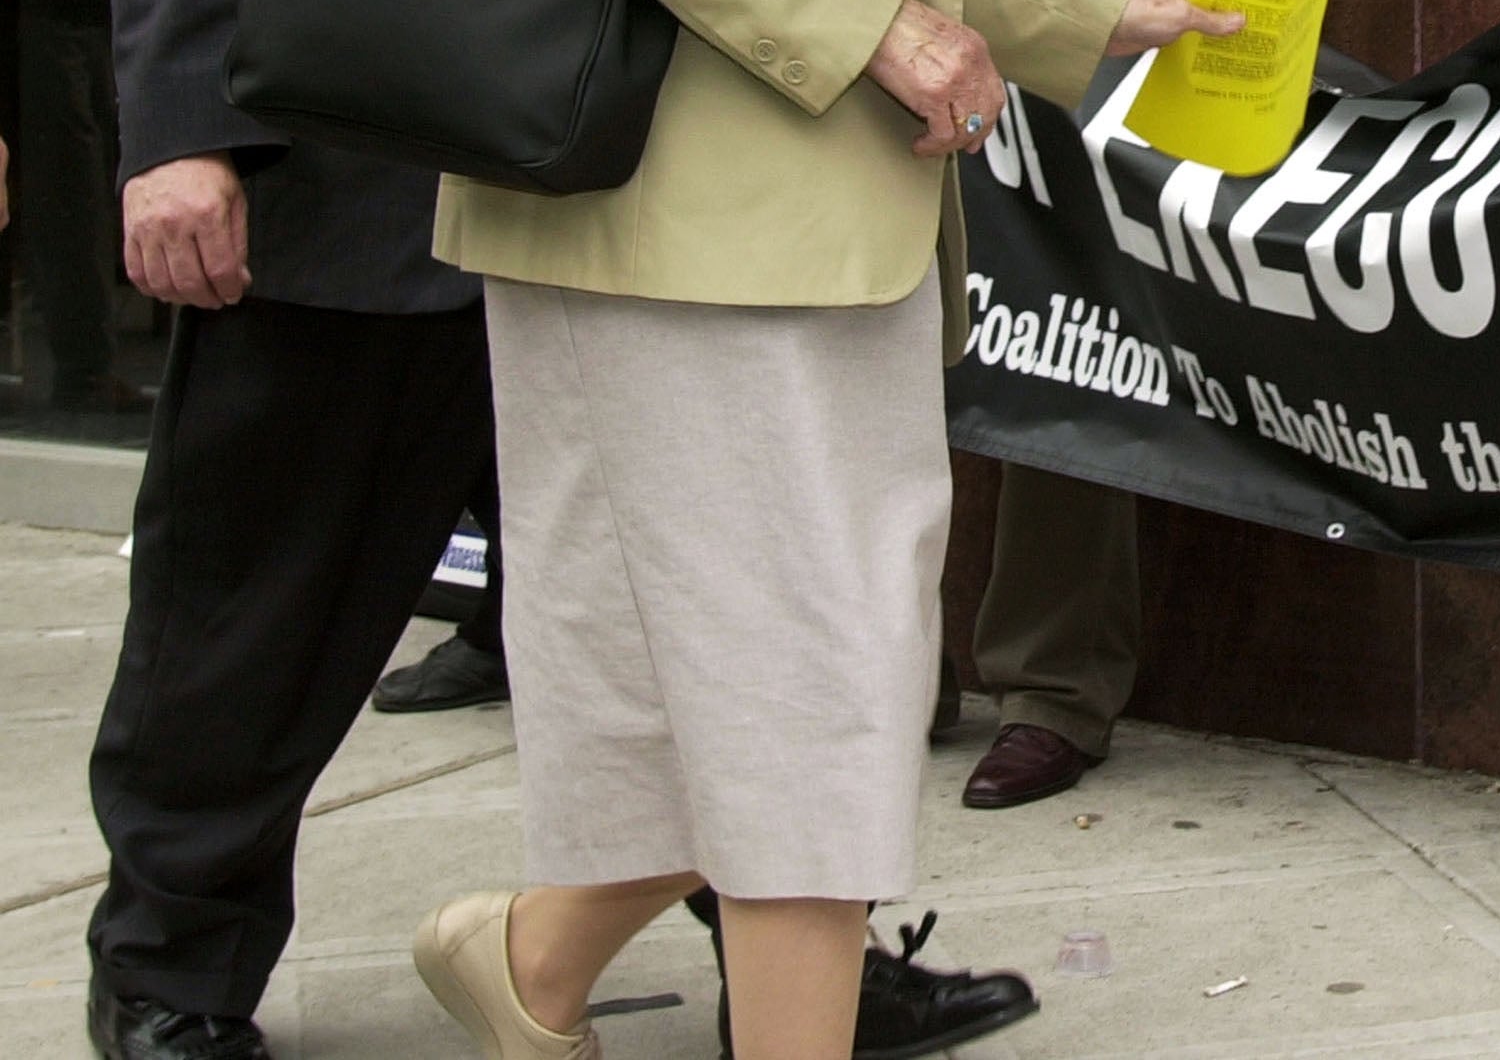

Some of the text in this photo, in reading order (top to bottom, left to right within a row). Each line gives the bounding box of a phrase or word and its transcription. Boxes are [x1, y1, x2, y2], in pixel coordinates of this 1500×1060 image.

[964, 272, 1170, 406] Coalition
[1171, 344, 1238, 426] To
[1246, 374, 1428, 491] Abolish
